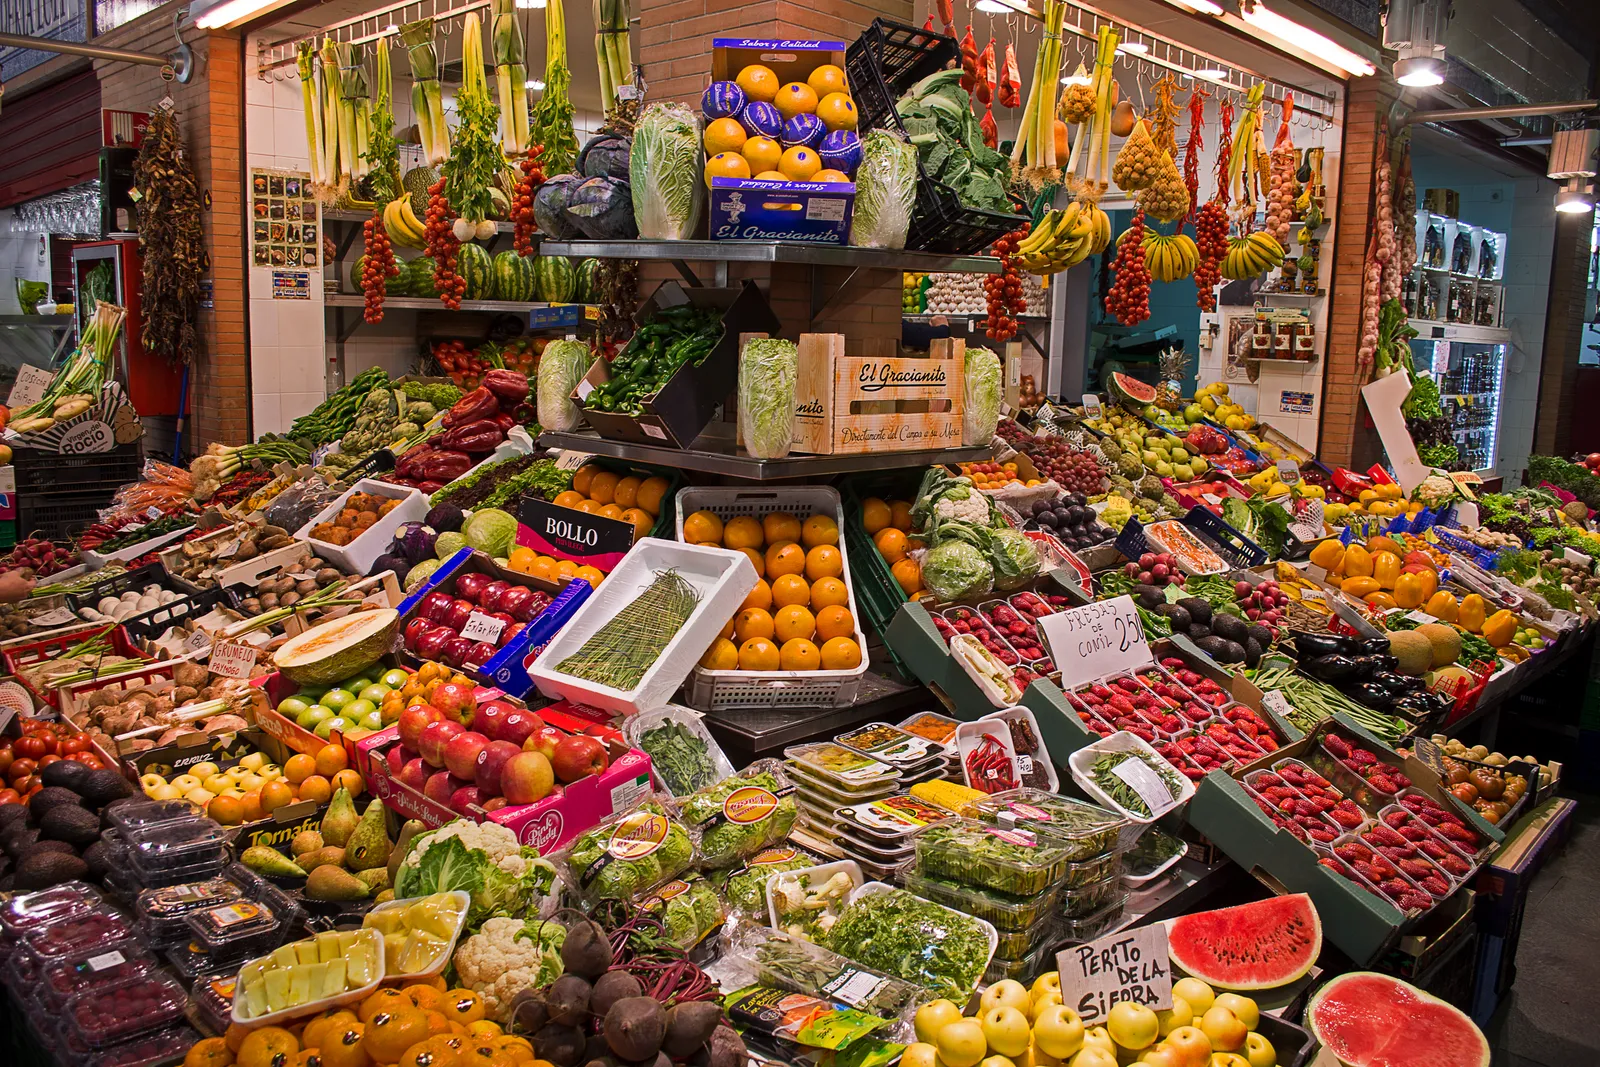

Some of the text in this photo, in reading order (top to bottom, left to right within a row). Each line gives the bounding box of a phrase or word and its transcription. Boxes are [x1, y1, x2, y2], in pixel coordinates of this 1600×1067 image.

[739, 39, 769, 48] Sabor
[780, 40, 821, 48] Calidad
[739, 180, 782, 190] Calidad
[795, 182, 827, 191] Sabor
[716, 225, 840, 242] El Gracianito
[859, 363, 946, 386] El Gracianito
[66, 421, 102, 444] Virgen del
[841, 427, 886, 445] Directamente
[887, 425, 899, 440] del
[899, 424, 922, 442] Campo
[939, 422, 960, 439] Mesa
[546, 517, 598, 546] BOLLO
[555, 537, 585, 552] PRIVILEGE
[1064, 600, 1117, 632] FRESAS
[1091, 622, 1104, 633] DE
[214, 642, 254, 663] GRUMELO
[391, 791, 445, 828] Pink Lady
[527, 817, 553, 845] Pink
[535, 826, 558, 850] Lady
[1116, 959, 1166, 985] DE LA
